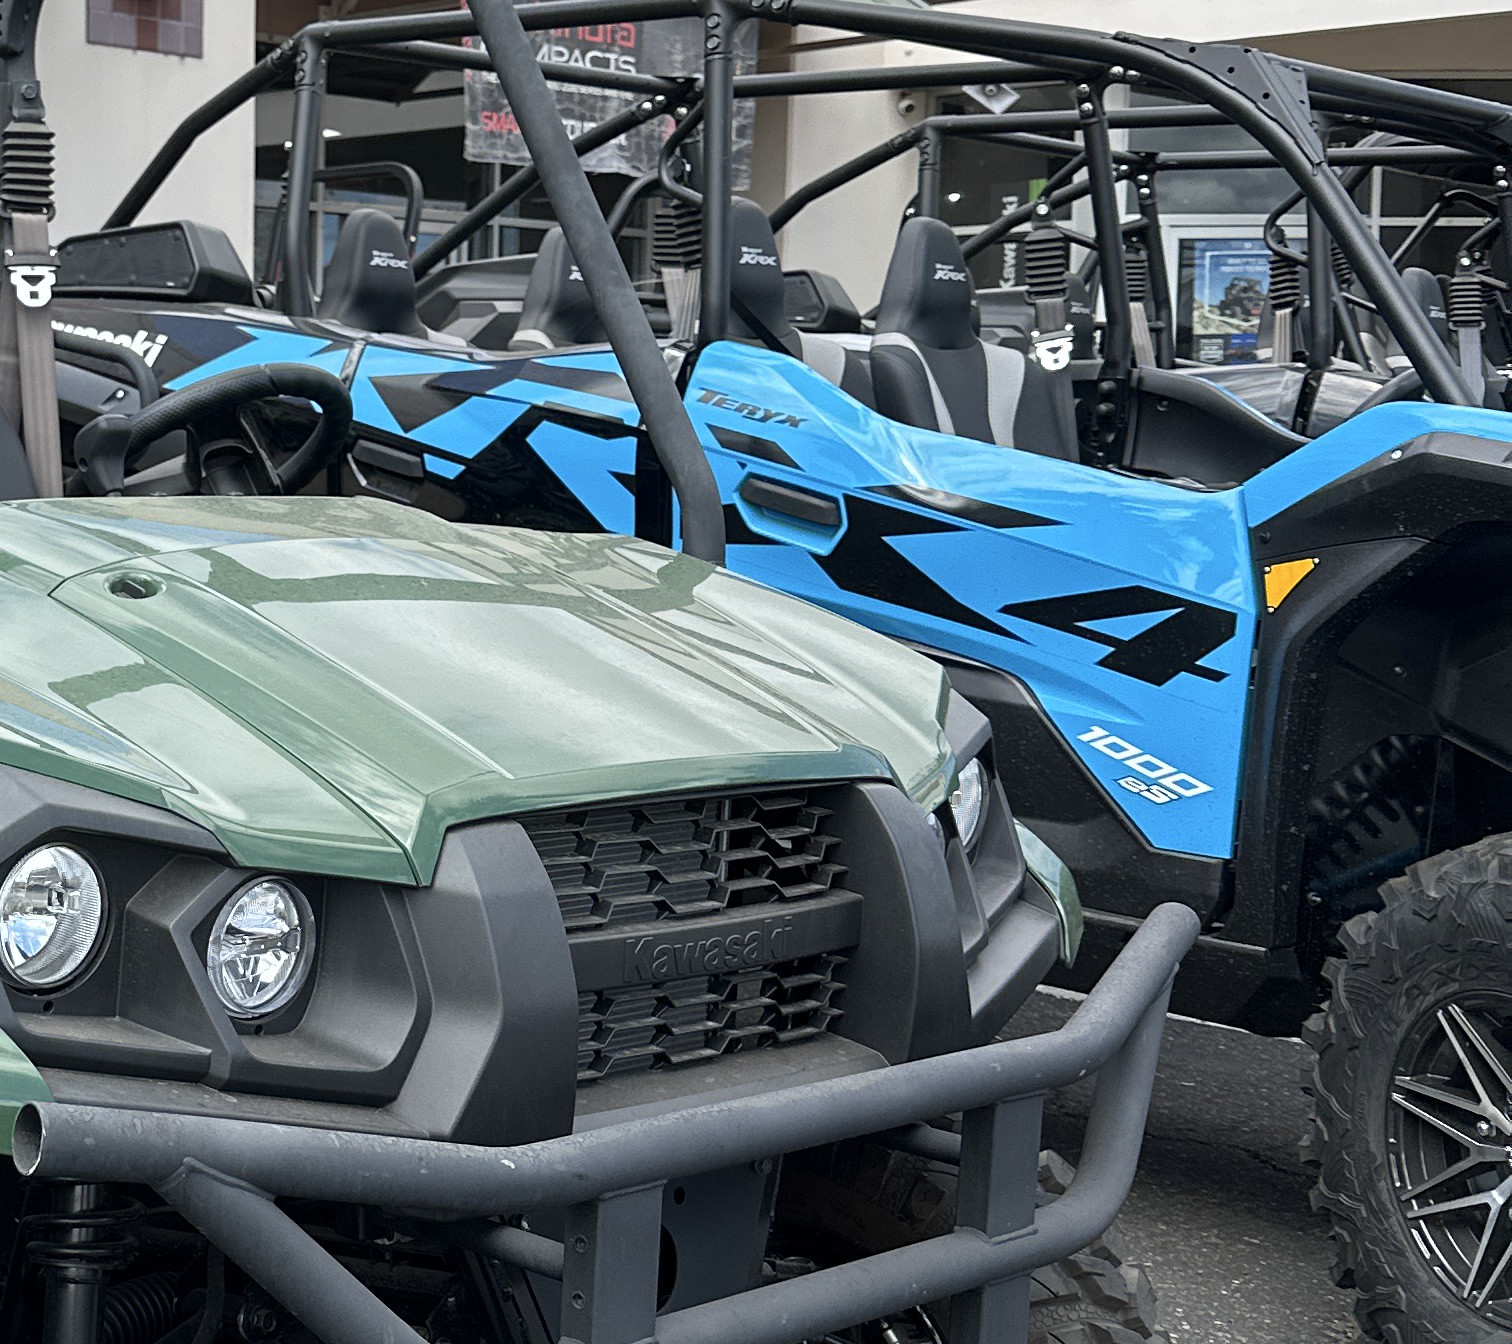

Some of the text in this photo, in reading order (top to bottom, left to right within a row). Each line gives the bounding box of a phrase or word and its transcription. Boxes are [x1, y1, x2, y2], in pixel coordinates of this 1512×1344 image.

[696, 387, 809, 429] TERYX
[1076, 725, 1215, 798] 1000
[622, 916, 793, 984] Kawasaki
